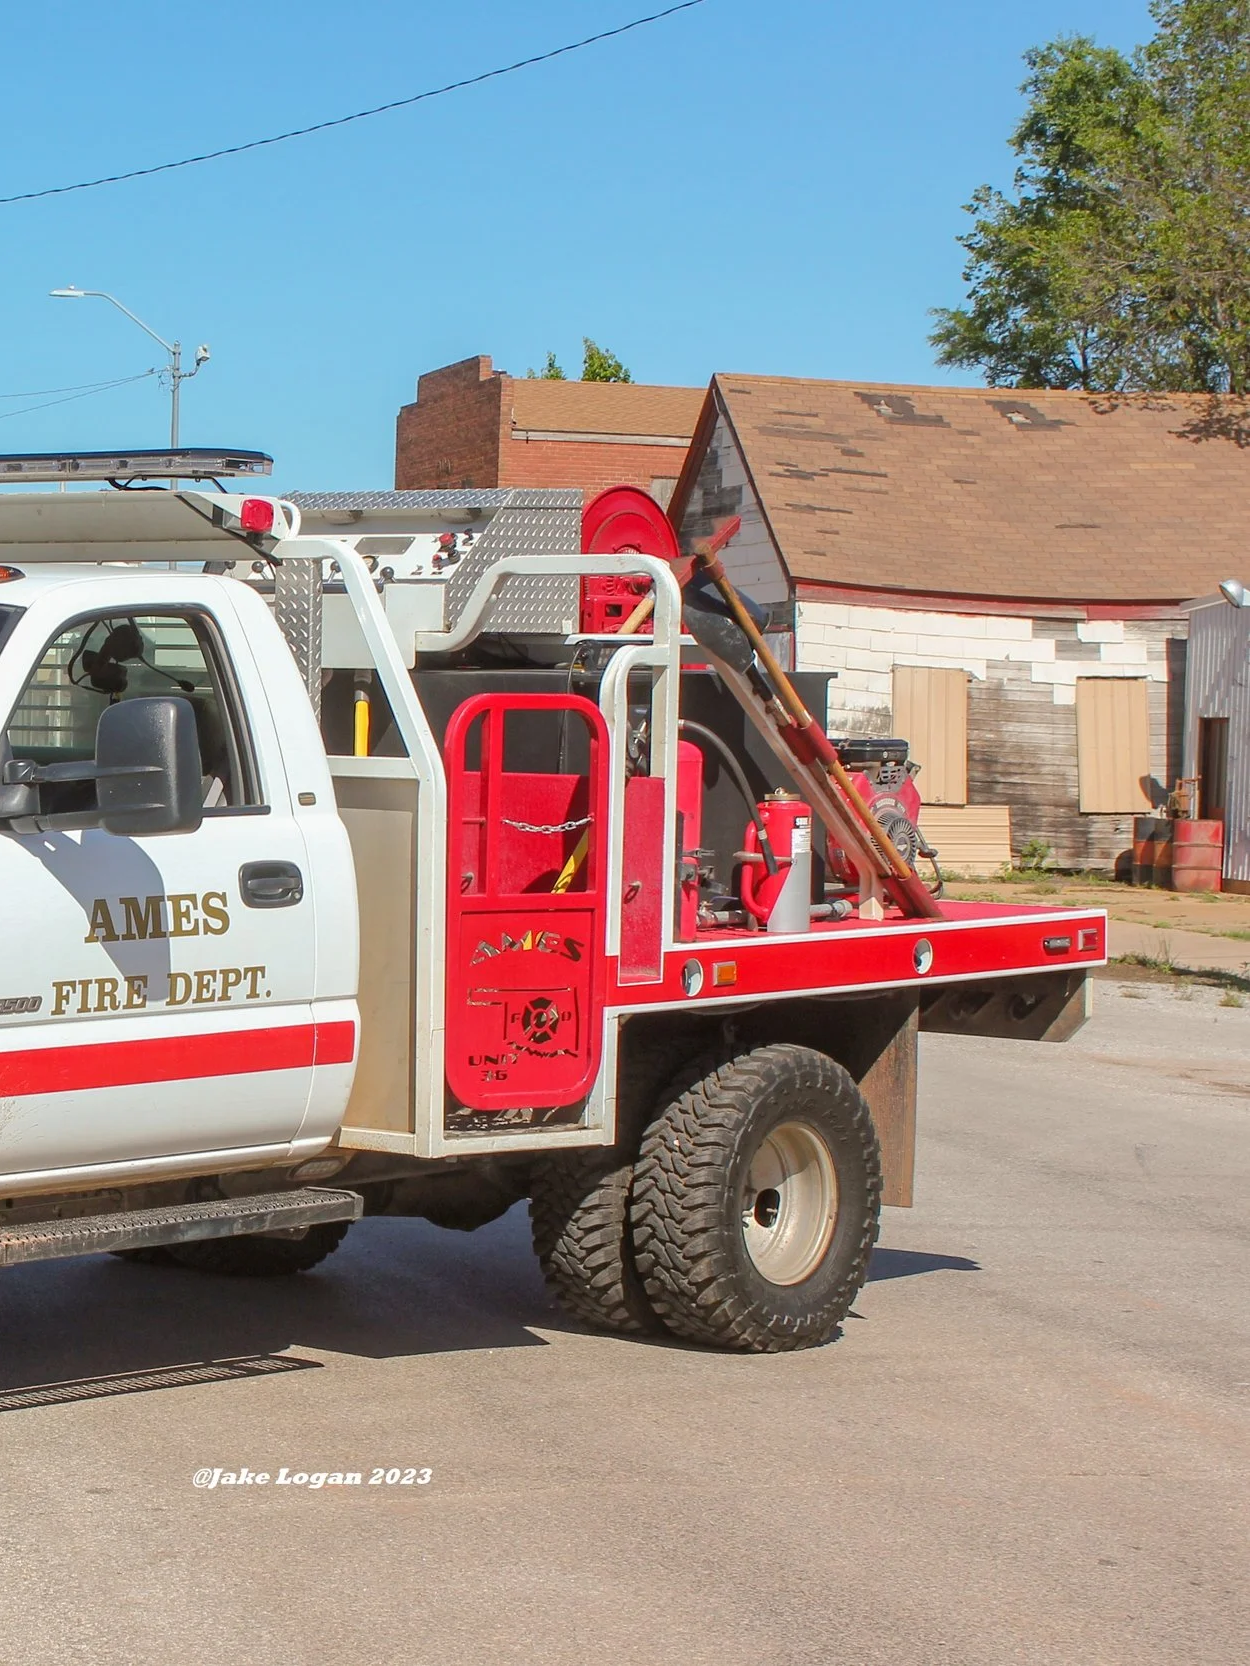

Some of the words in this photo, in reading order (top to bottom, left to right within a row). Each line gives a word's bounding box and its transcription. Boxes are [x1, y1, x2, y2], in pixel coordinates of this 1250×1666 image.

[84, 891, 231, 943] AMES
[469, 929, 585, 967] AMES
[50, 975, 148, 1016] FIRE
[165, 965, 272, 1006] DEPT.
[468, 1053, 519, 1067] UNIT
[480, 1070, 508, 1082] 36
